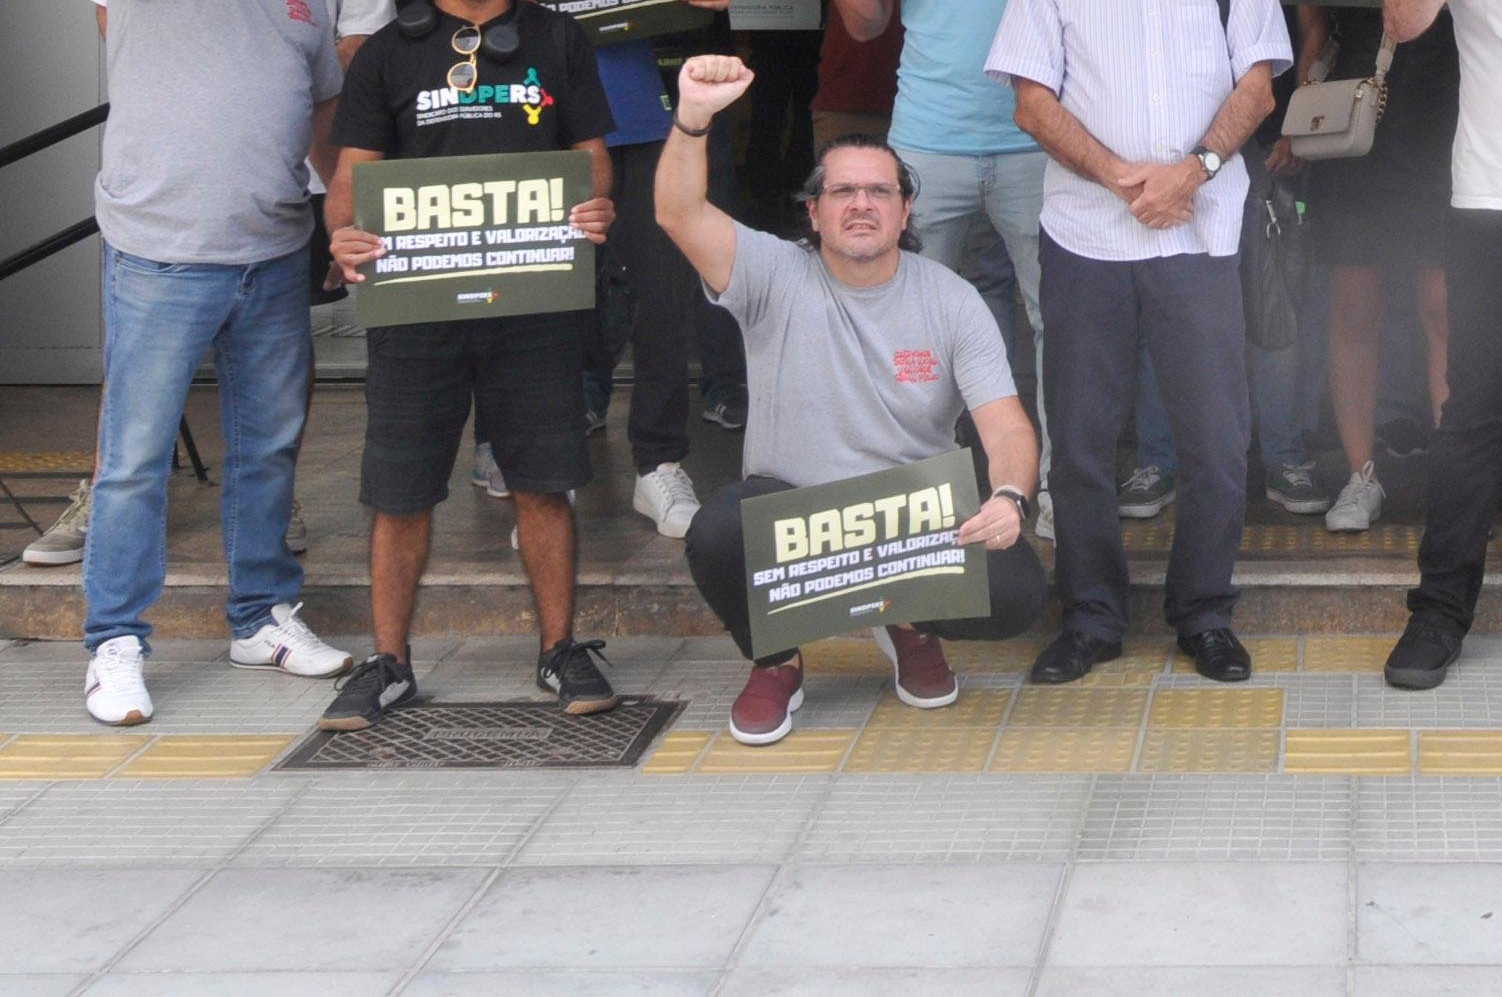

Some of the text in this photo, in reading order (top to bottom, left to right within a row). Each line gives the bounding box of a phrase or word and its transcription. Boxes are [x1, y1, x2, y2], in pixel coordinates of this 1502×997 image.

[416, 84, 541, 111] SINDPERS
[384, 178, 564, 231] BASTA!
[396, 232, 468, 250] RESPEITO
[377, 247, 574, 273] NÃO PODEMOS CONTINUAR!
[774, 482, 955, 563] BASTA!
[753, 567, 784, 586] SEM
[789, 551, 859, 578] RESPEITO
[769, 549, 965, 602] NÃO PODEMOS CONTINUAR!
